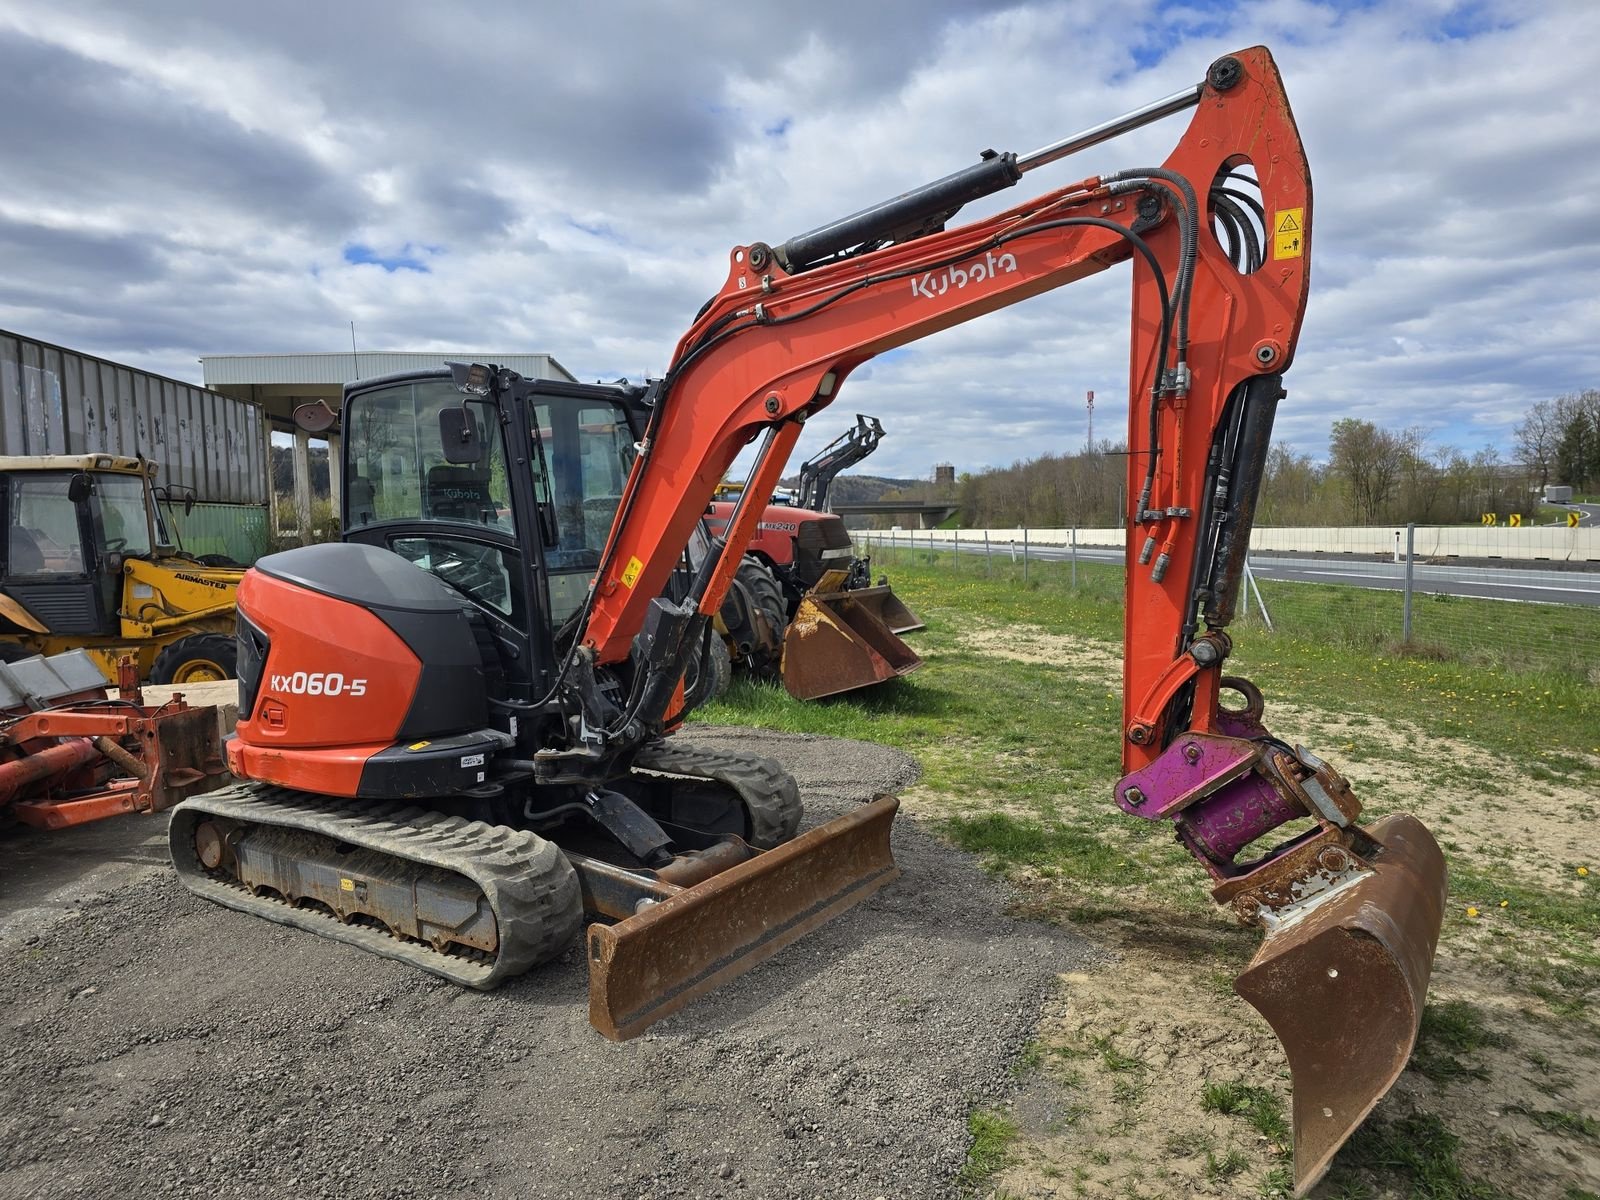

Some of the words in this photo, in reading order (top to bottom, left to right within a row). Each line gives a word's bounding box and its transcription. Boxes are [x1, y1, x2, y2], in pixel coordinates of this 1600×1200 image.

[911, 251, 1017, 299] Kubota
[443, 488, 480, 500] Kubota
[174, 572, 227, 590] AIRMASTER
[270, 671, 367, 696] KX060-5
